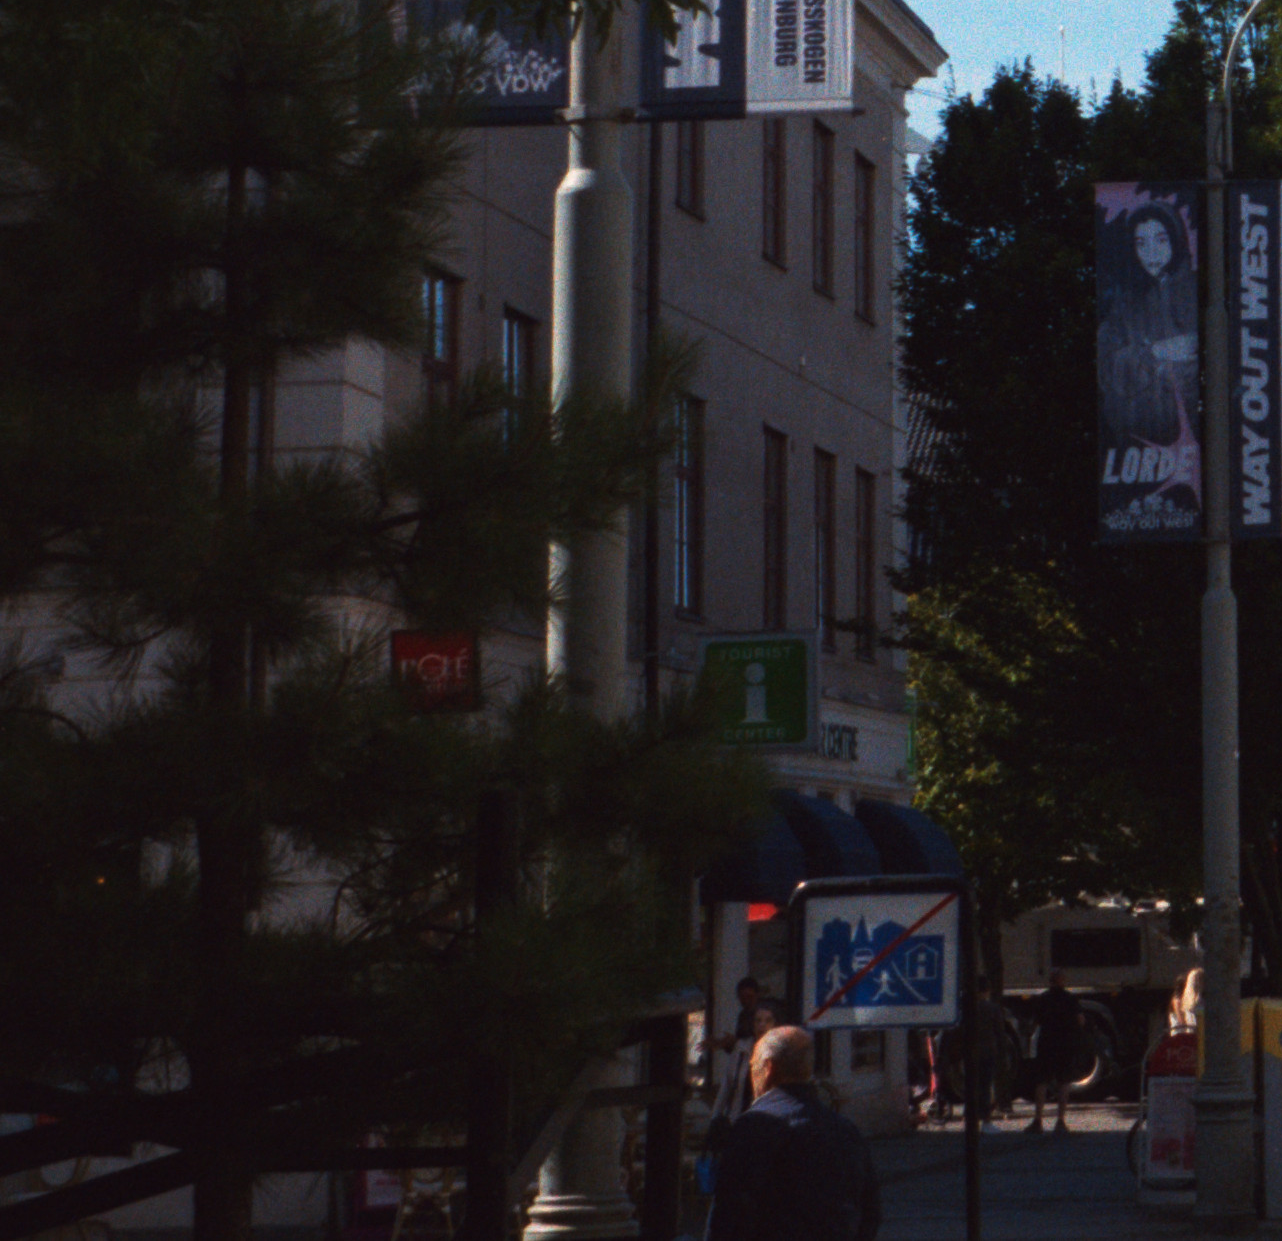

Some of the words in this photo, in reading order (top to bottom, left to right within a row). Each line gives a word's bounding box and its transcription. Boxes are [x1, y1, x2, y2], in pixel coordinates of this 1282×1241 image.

[1240, 194, 1269, 321] WEST
[1241, 326, 1270, 423] OUT
[1102, 445, 1197, 484] LORDE
[1242, 425, 1271, 526] WAY
[718, 644, 795, 661] TOURIST
[722, 727, 788, 742] CENTER
